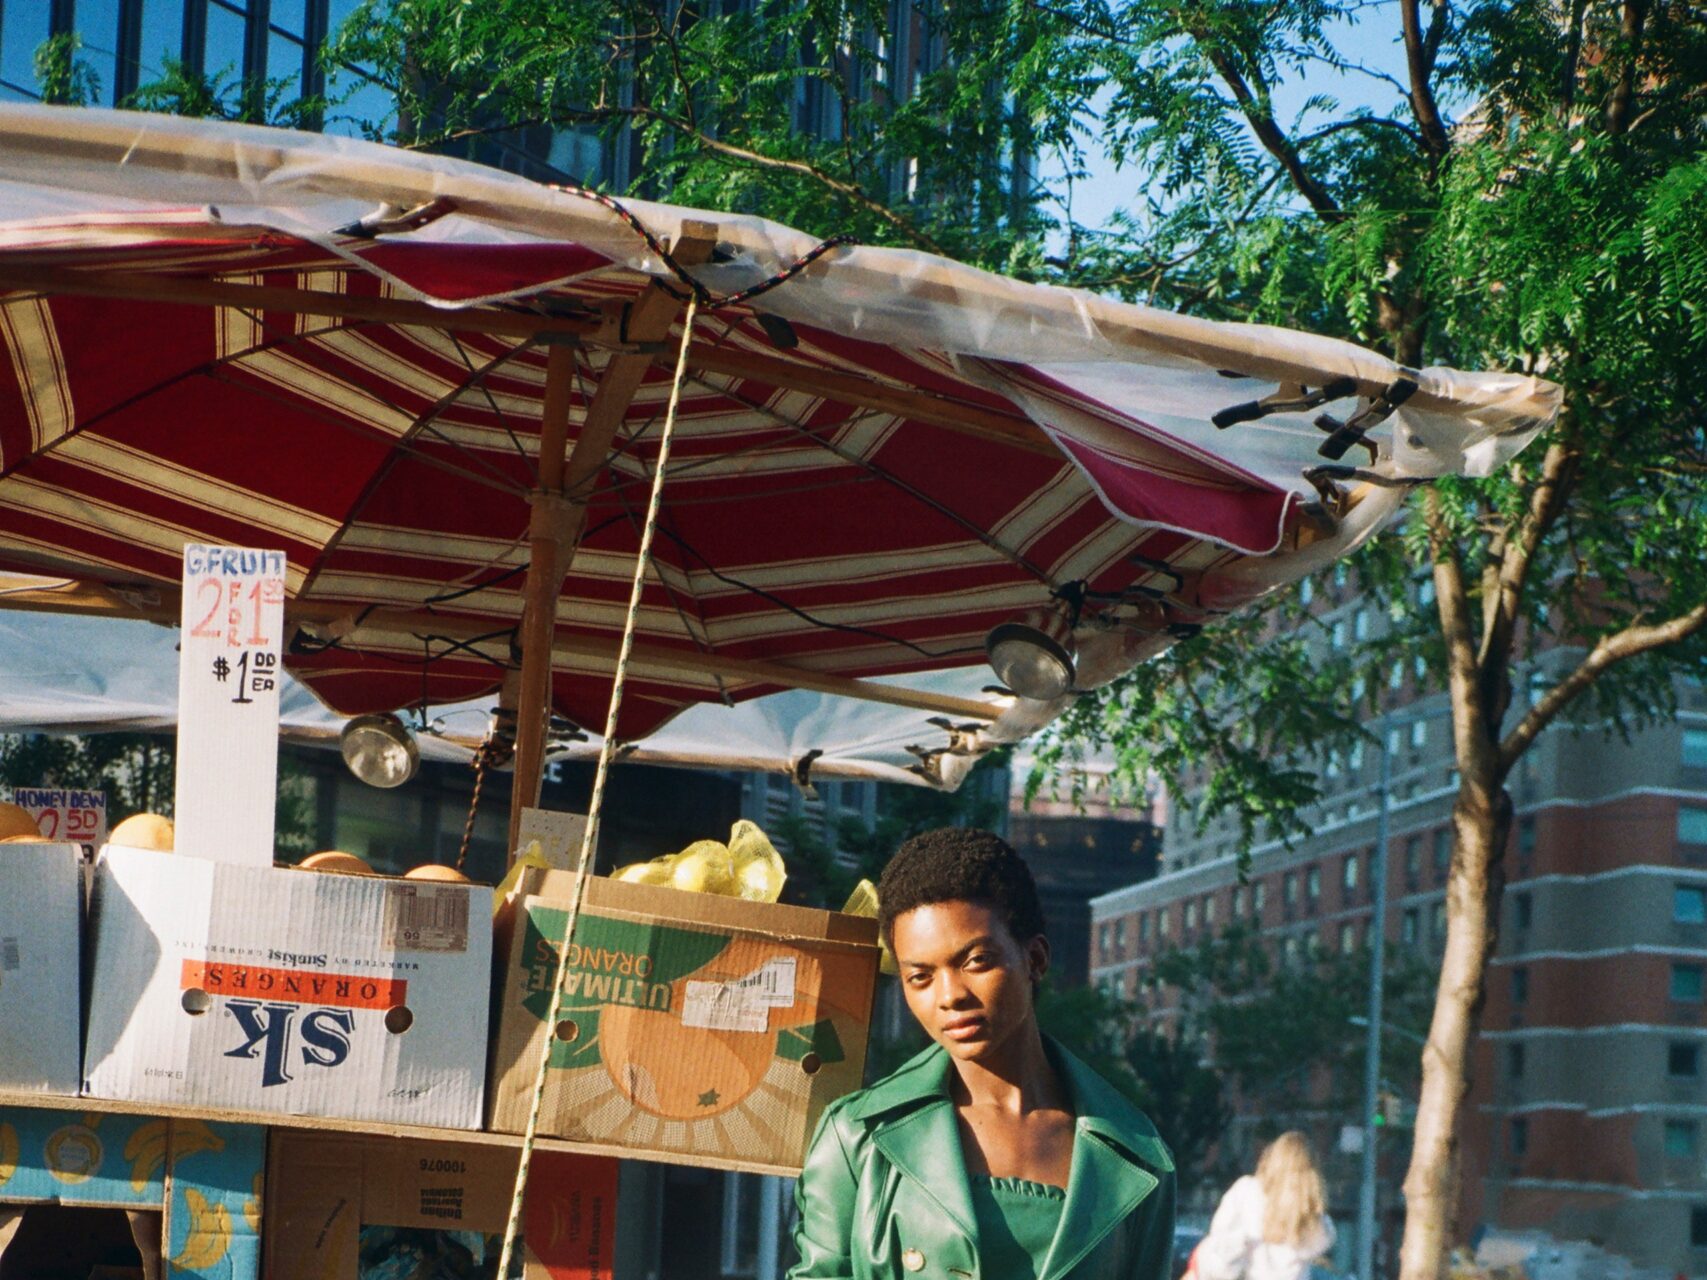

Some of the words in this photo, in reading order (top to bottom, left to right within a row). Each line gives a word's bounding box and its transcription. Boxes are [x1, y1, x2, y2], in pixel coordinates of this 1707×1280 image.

[190, 577, 223, 638] 2
[267, 948, 328, 968] Sunkist
[536, 938, 653, 978] ORANGES
[208, 967, 378, 1000] ORANGES
[531, 964, 670, 1009] ULTIMATE
